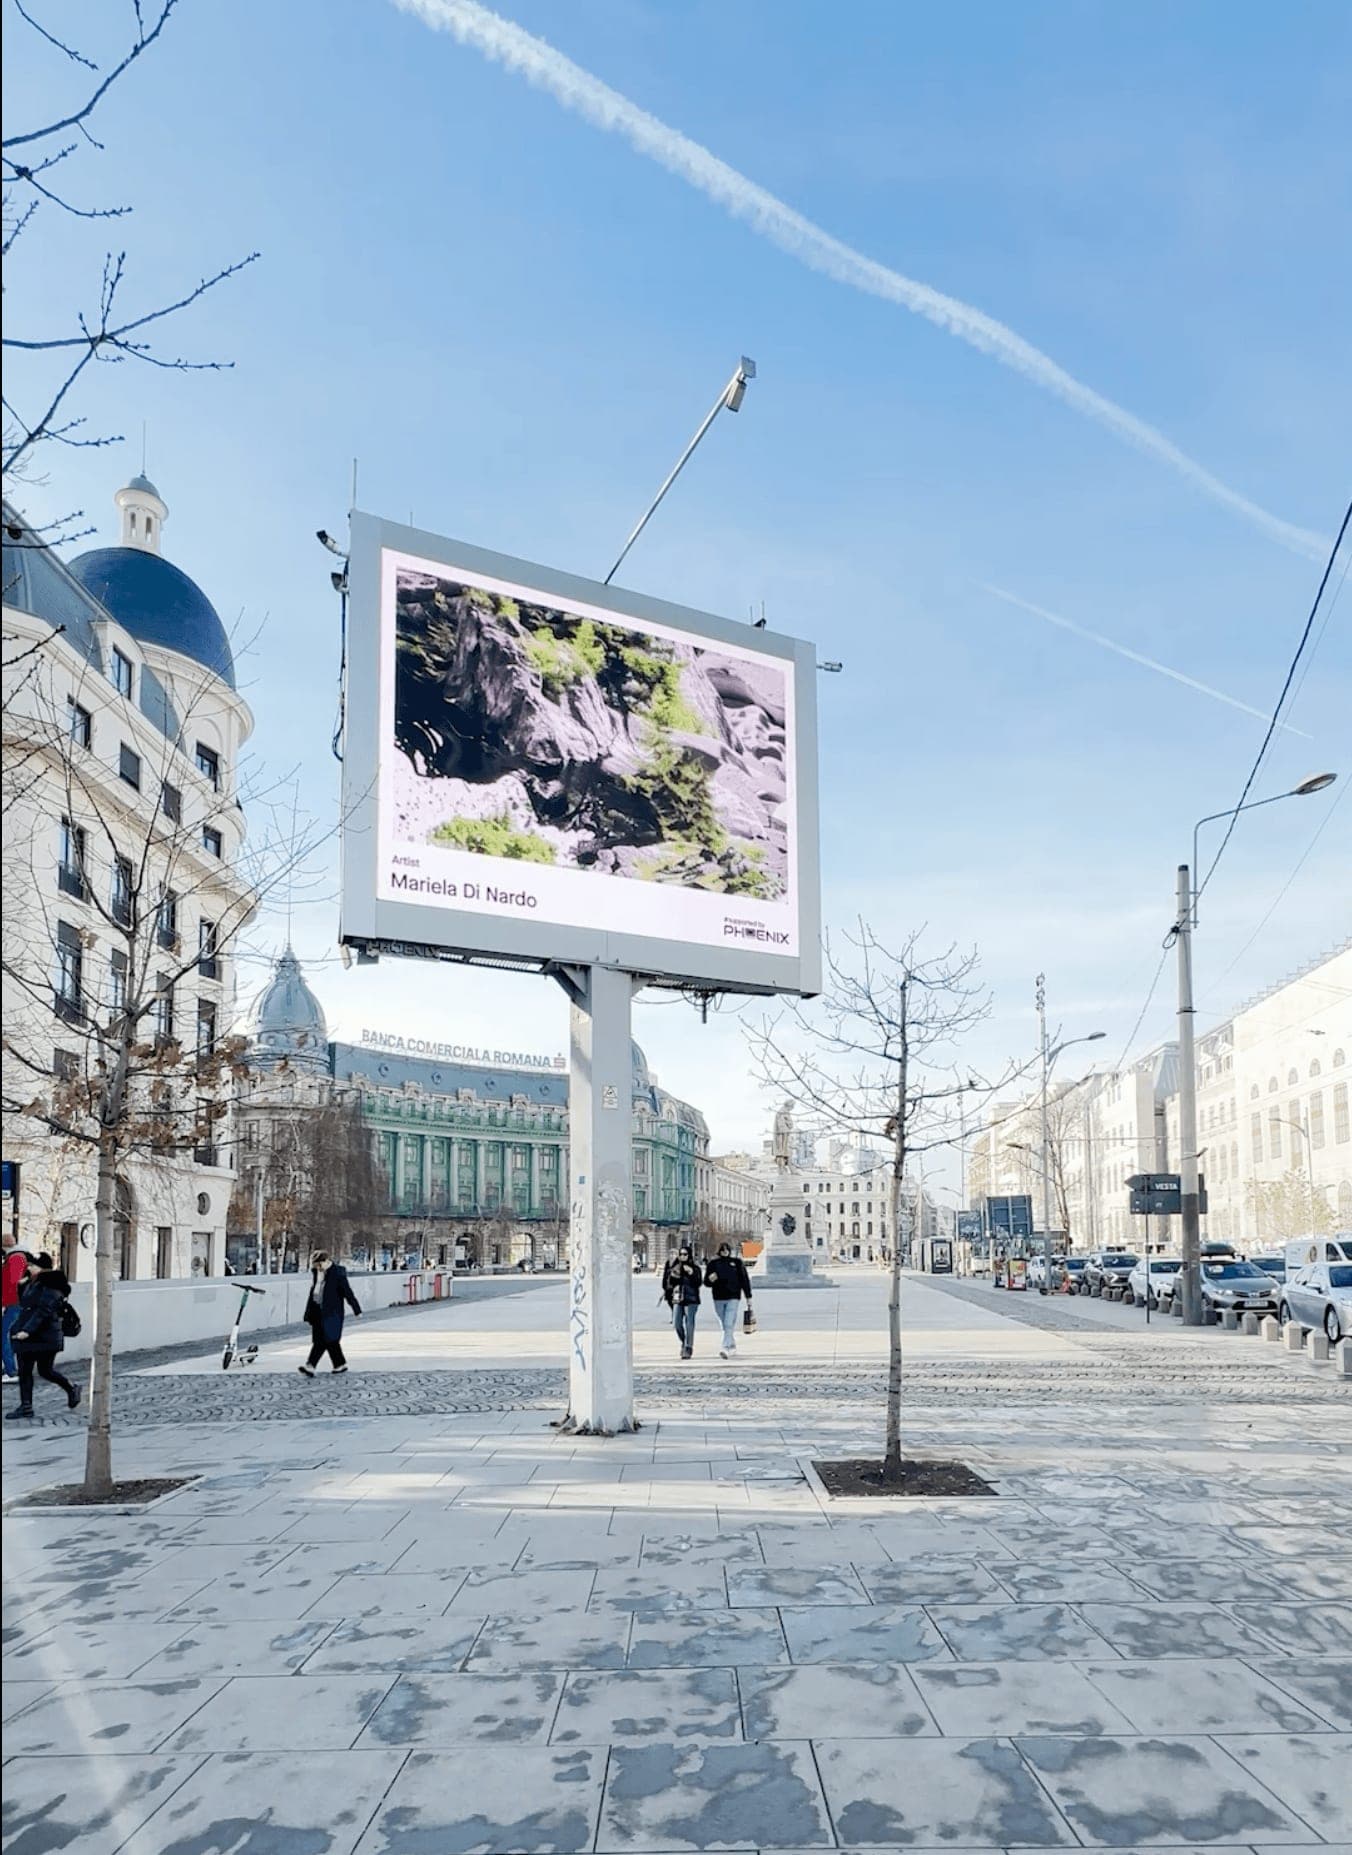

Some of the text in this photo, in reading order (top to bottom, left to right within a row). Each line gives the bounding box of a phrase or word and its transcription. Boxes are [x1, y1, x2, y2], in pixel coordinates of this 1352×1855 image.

[392, 855, 420, 867] Artist
[391, 872, 538, 908] Mariela Di Nardo
[361, 1028, 552, 1068] BANCA COMERCIALA ROMANA
